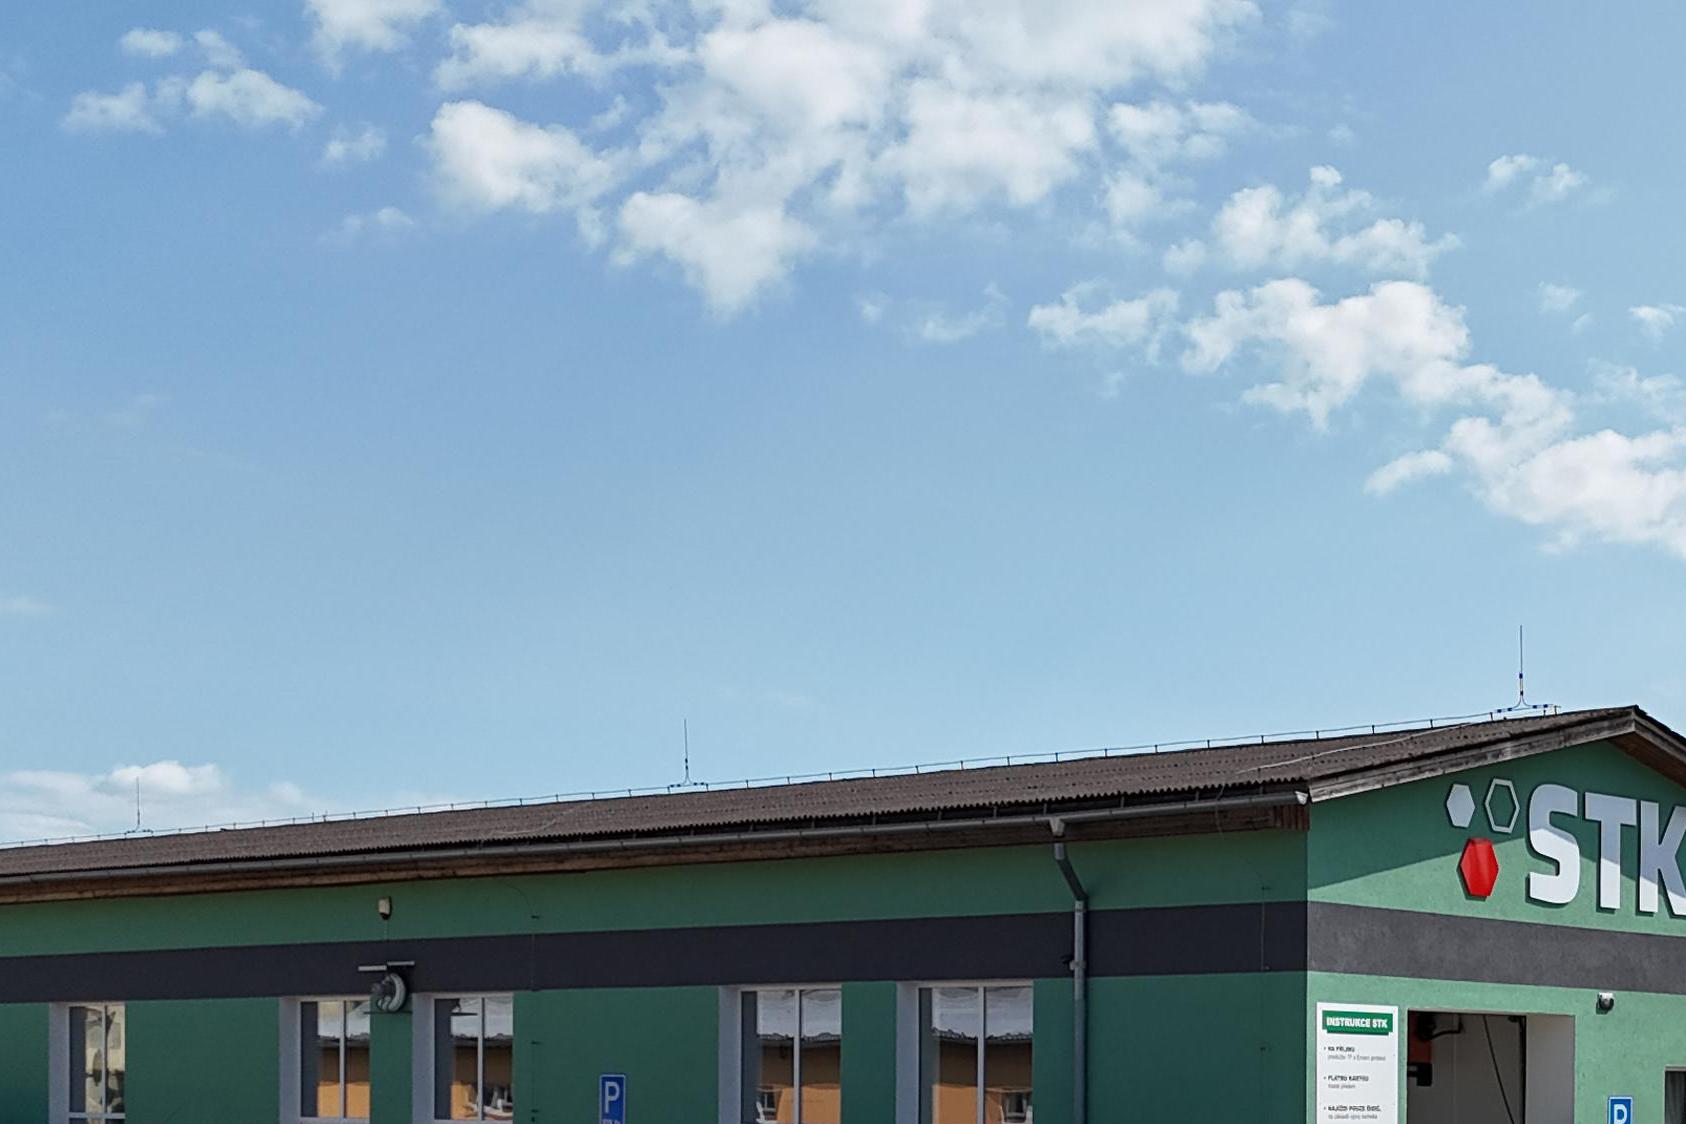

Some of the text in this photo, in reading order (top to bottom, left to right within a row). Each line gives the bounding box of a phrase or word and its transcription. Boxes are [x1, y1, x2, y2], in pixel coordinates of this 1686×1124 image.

[1326, 1016, 1388, 1029] INSTRUKCE STK
[605, 1081, 620, 1113] P
